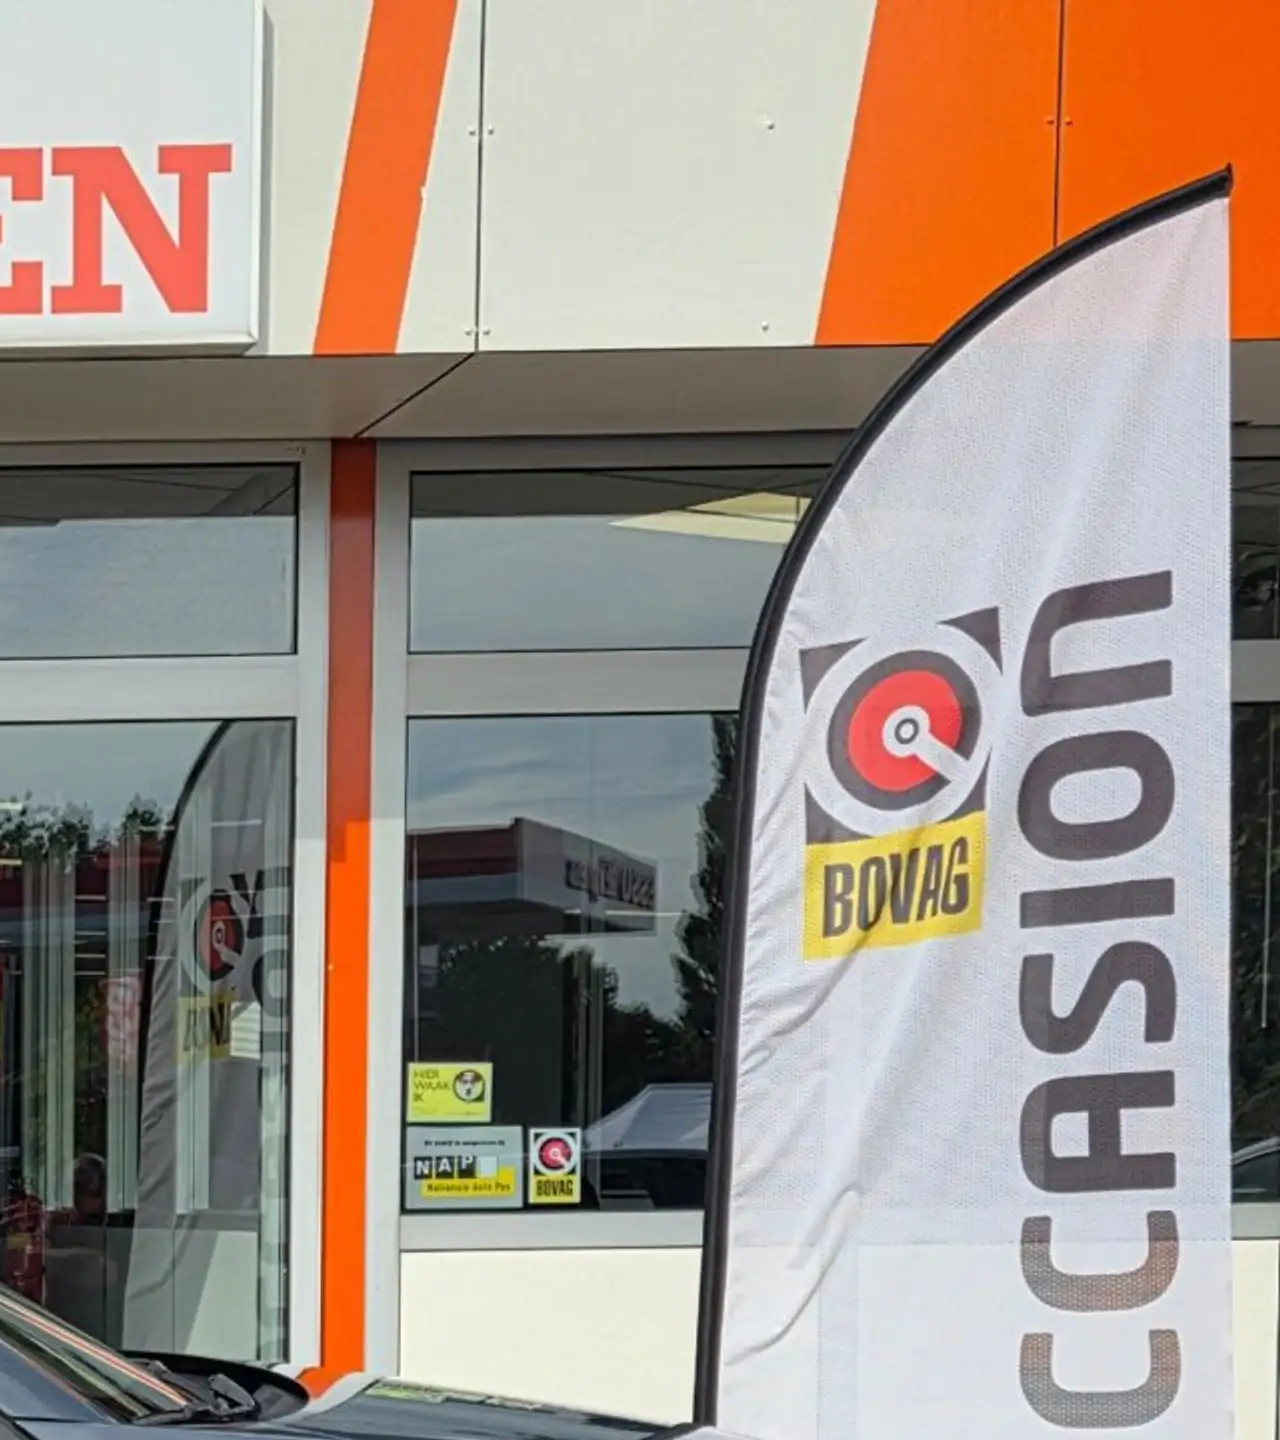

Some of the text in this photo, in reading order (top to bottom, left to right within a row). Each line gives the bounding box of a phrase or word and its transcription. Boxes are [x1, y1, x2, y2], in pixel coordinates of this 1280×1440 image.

[822, 836, 969, 939] BOVAG
[415, 1153, 475, 1177] NAP
[535, 1179, 574, 1198] BOVAG
